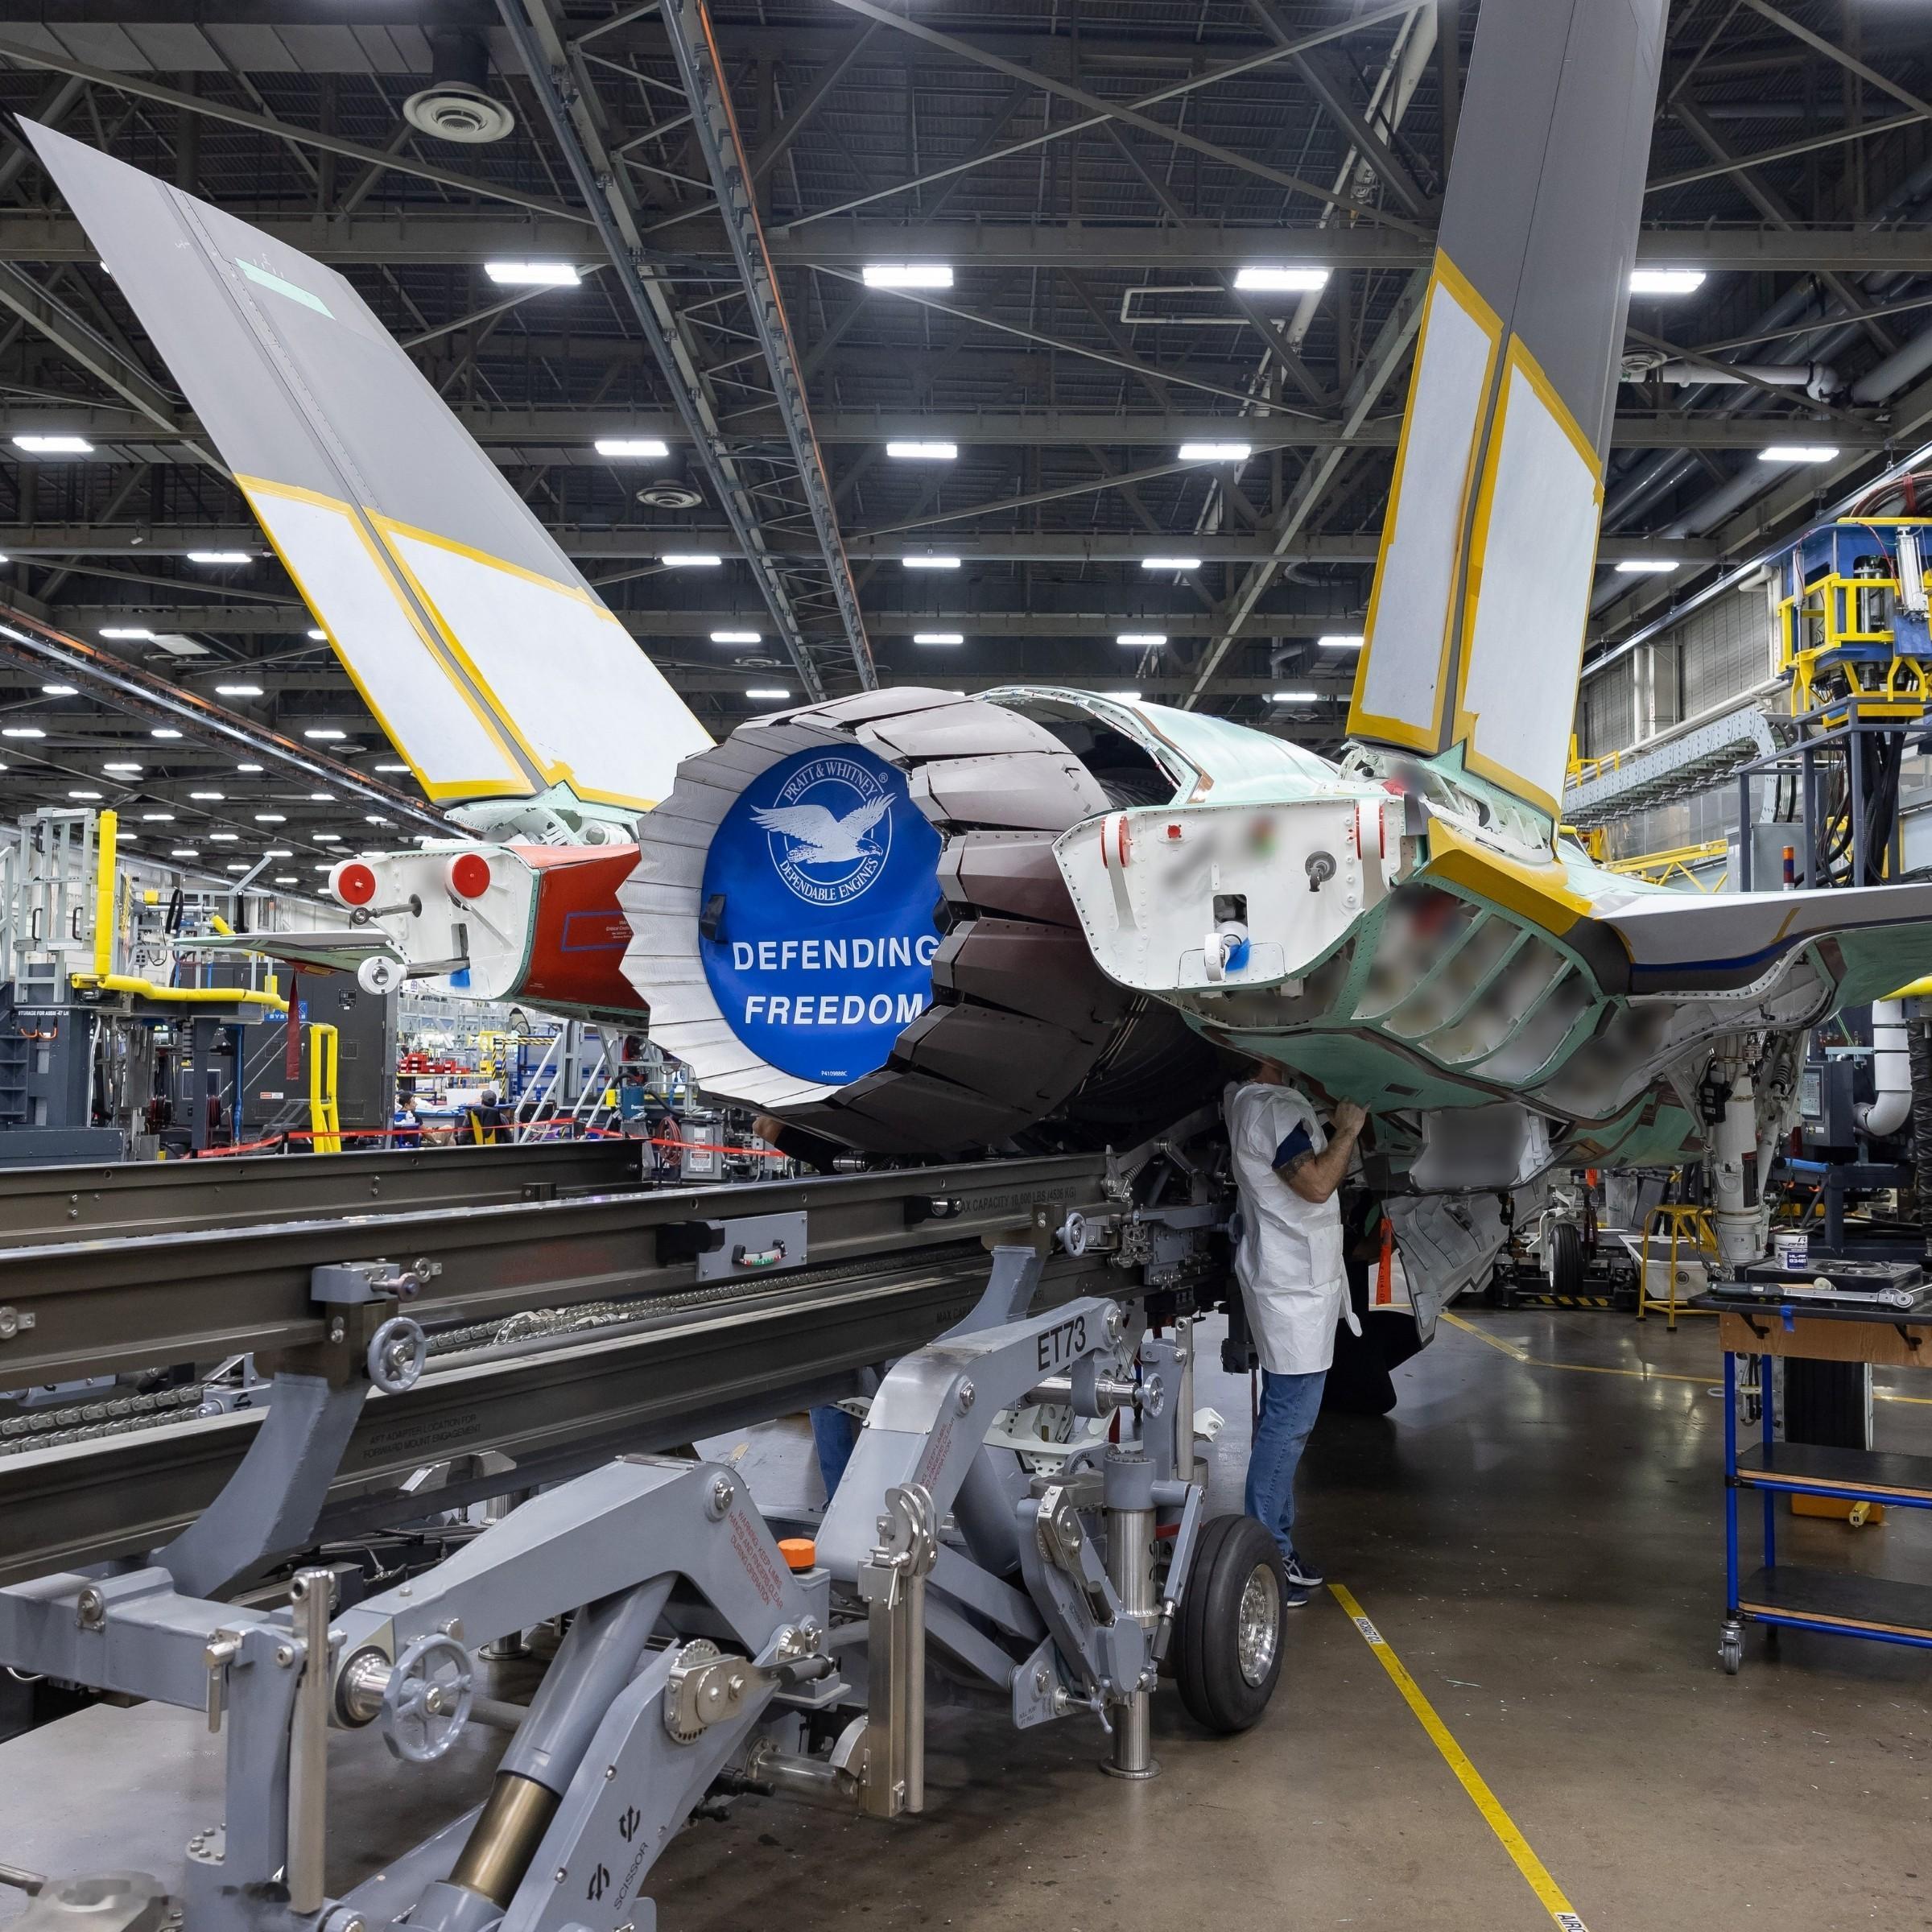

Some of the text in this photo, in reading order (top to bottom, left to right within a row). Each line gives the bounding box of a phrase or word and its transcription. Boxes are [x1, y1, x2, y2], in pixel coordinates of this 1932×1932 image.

[784, 766, 814, 801] PRATT
[816, 764, 824, 778] &
[826, 762, 877, 796] WHITNEY
[780, 858, 878, 900] DEPENDABLE ENGINES
[733, 935, 939, 970] DEFENDING
[745, 993, 923, 1025] FREEDOM
[972, 1195, 1009, 1212] CAPACITY
[1033, 1190, 1046, 1203] LBS
[1038, 1315, 1086, 1372] ET73
[363, 1424, 481, 1458] FORWARD MOUNT ENGAGEMENT
[386, 1426, 423, 1442] ADAPTER
[423, 1418, 460, 1434] LOCATION
[461, 1414, 477, 1425] FOR
[729, 1512, 745, 1540] HANDS
[743, 1538, 753, 1554] AND
[768, 1584, 783, 1610] CLEAR
[730, 1534, 770, 1606] DURING OPERATION
[758, 1546, 770, 1565] KEEP
[614, 1842, 649, 1910] SCISSOR
